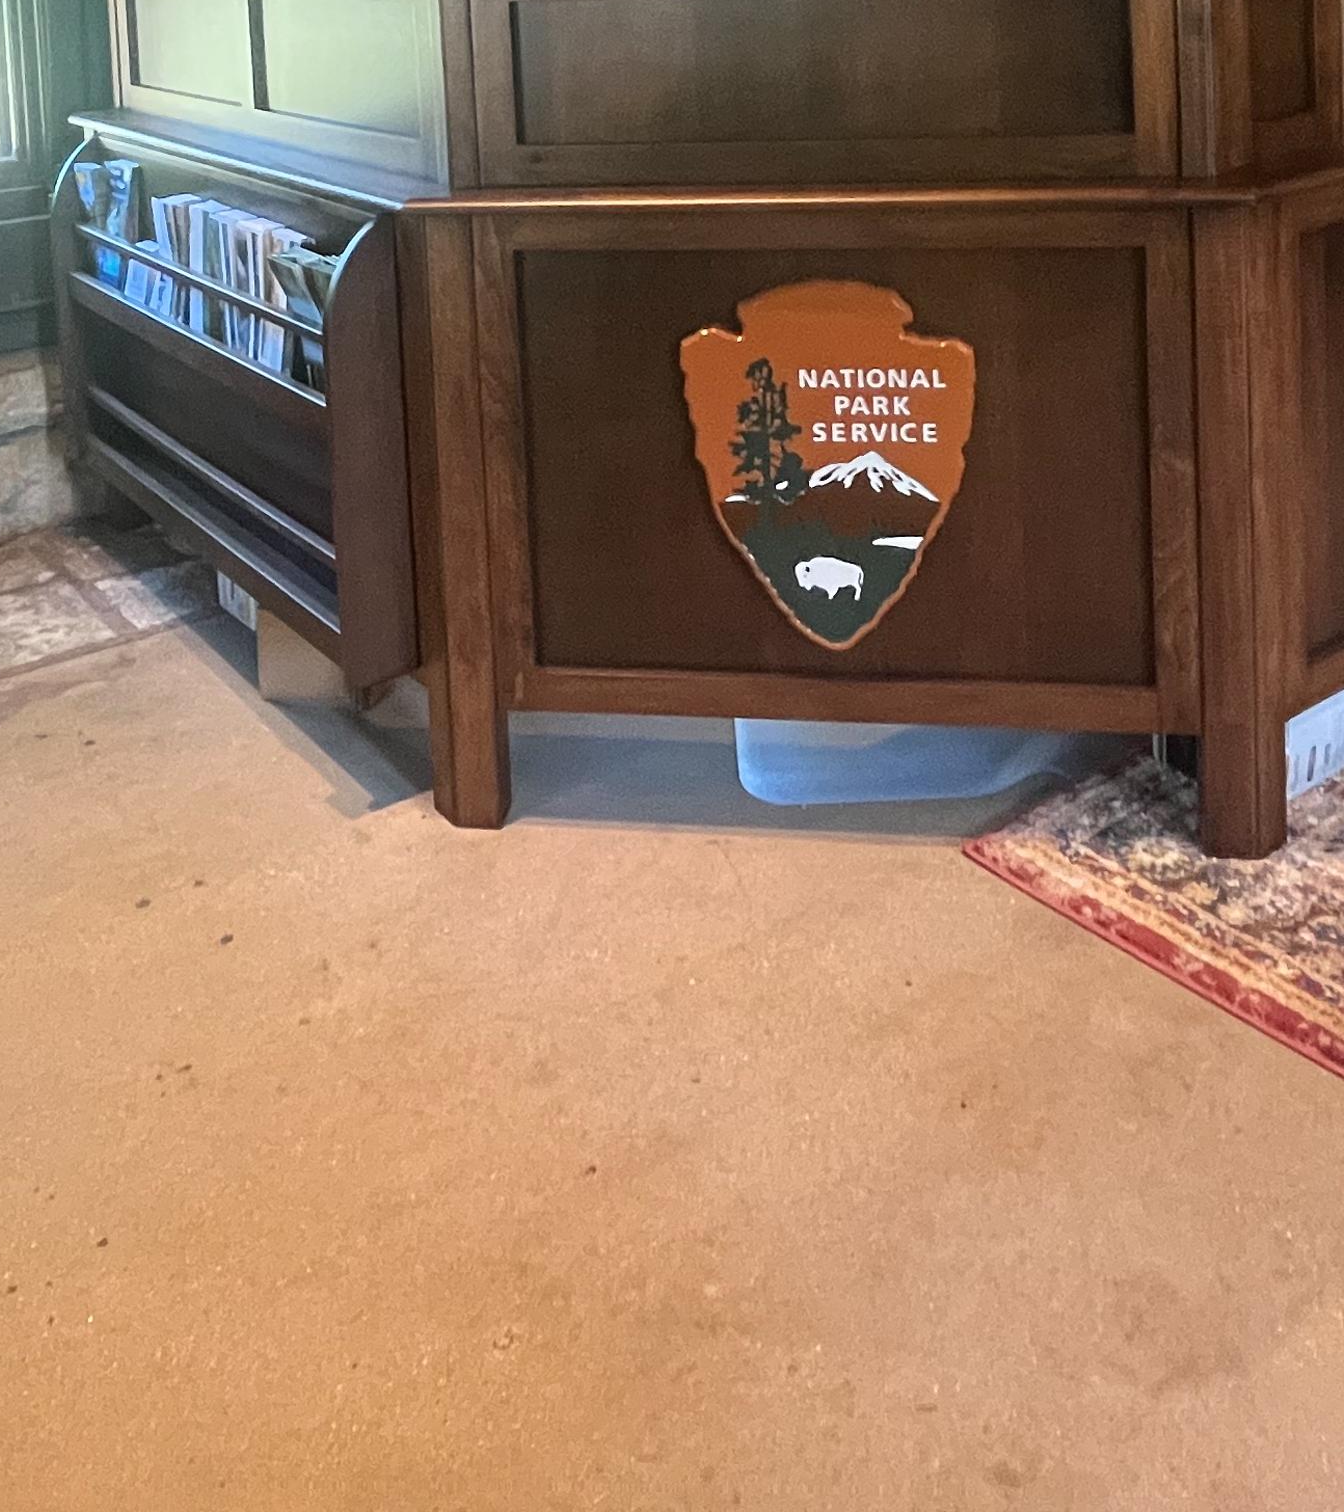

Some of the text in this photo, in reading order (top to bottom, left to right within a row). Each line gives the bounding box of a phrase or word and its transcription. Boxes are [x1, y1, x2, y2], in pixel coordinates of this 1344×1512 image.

[798, 368, 947, 389] NATIONAL
[834, 396, 911, 416] PARK
[812, 422, 938, 443] SERVICE
